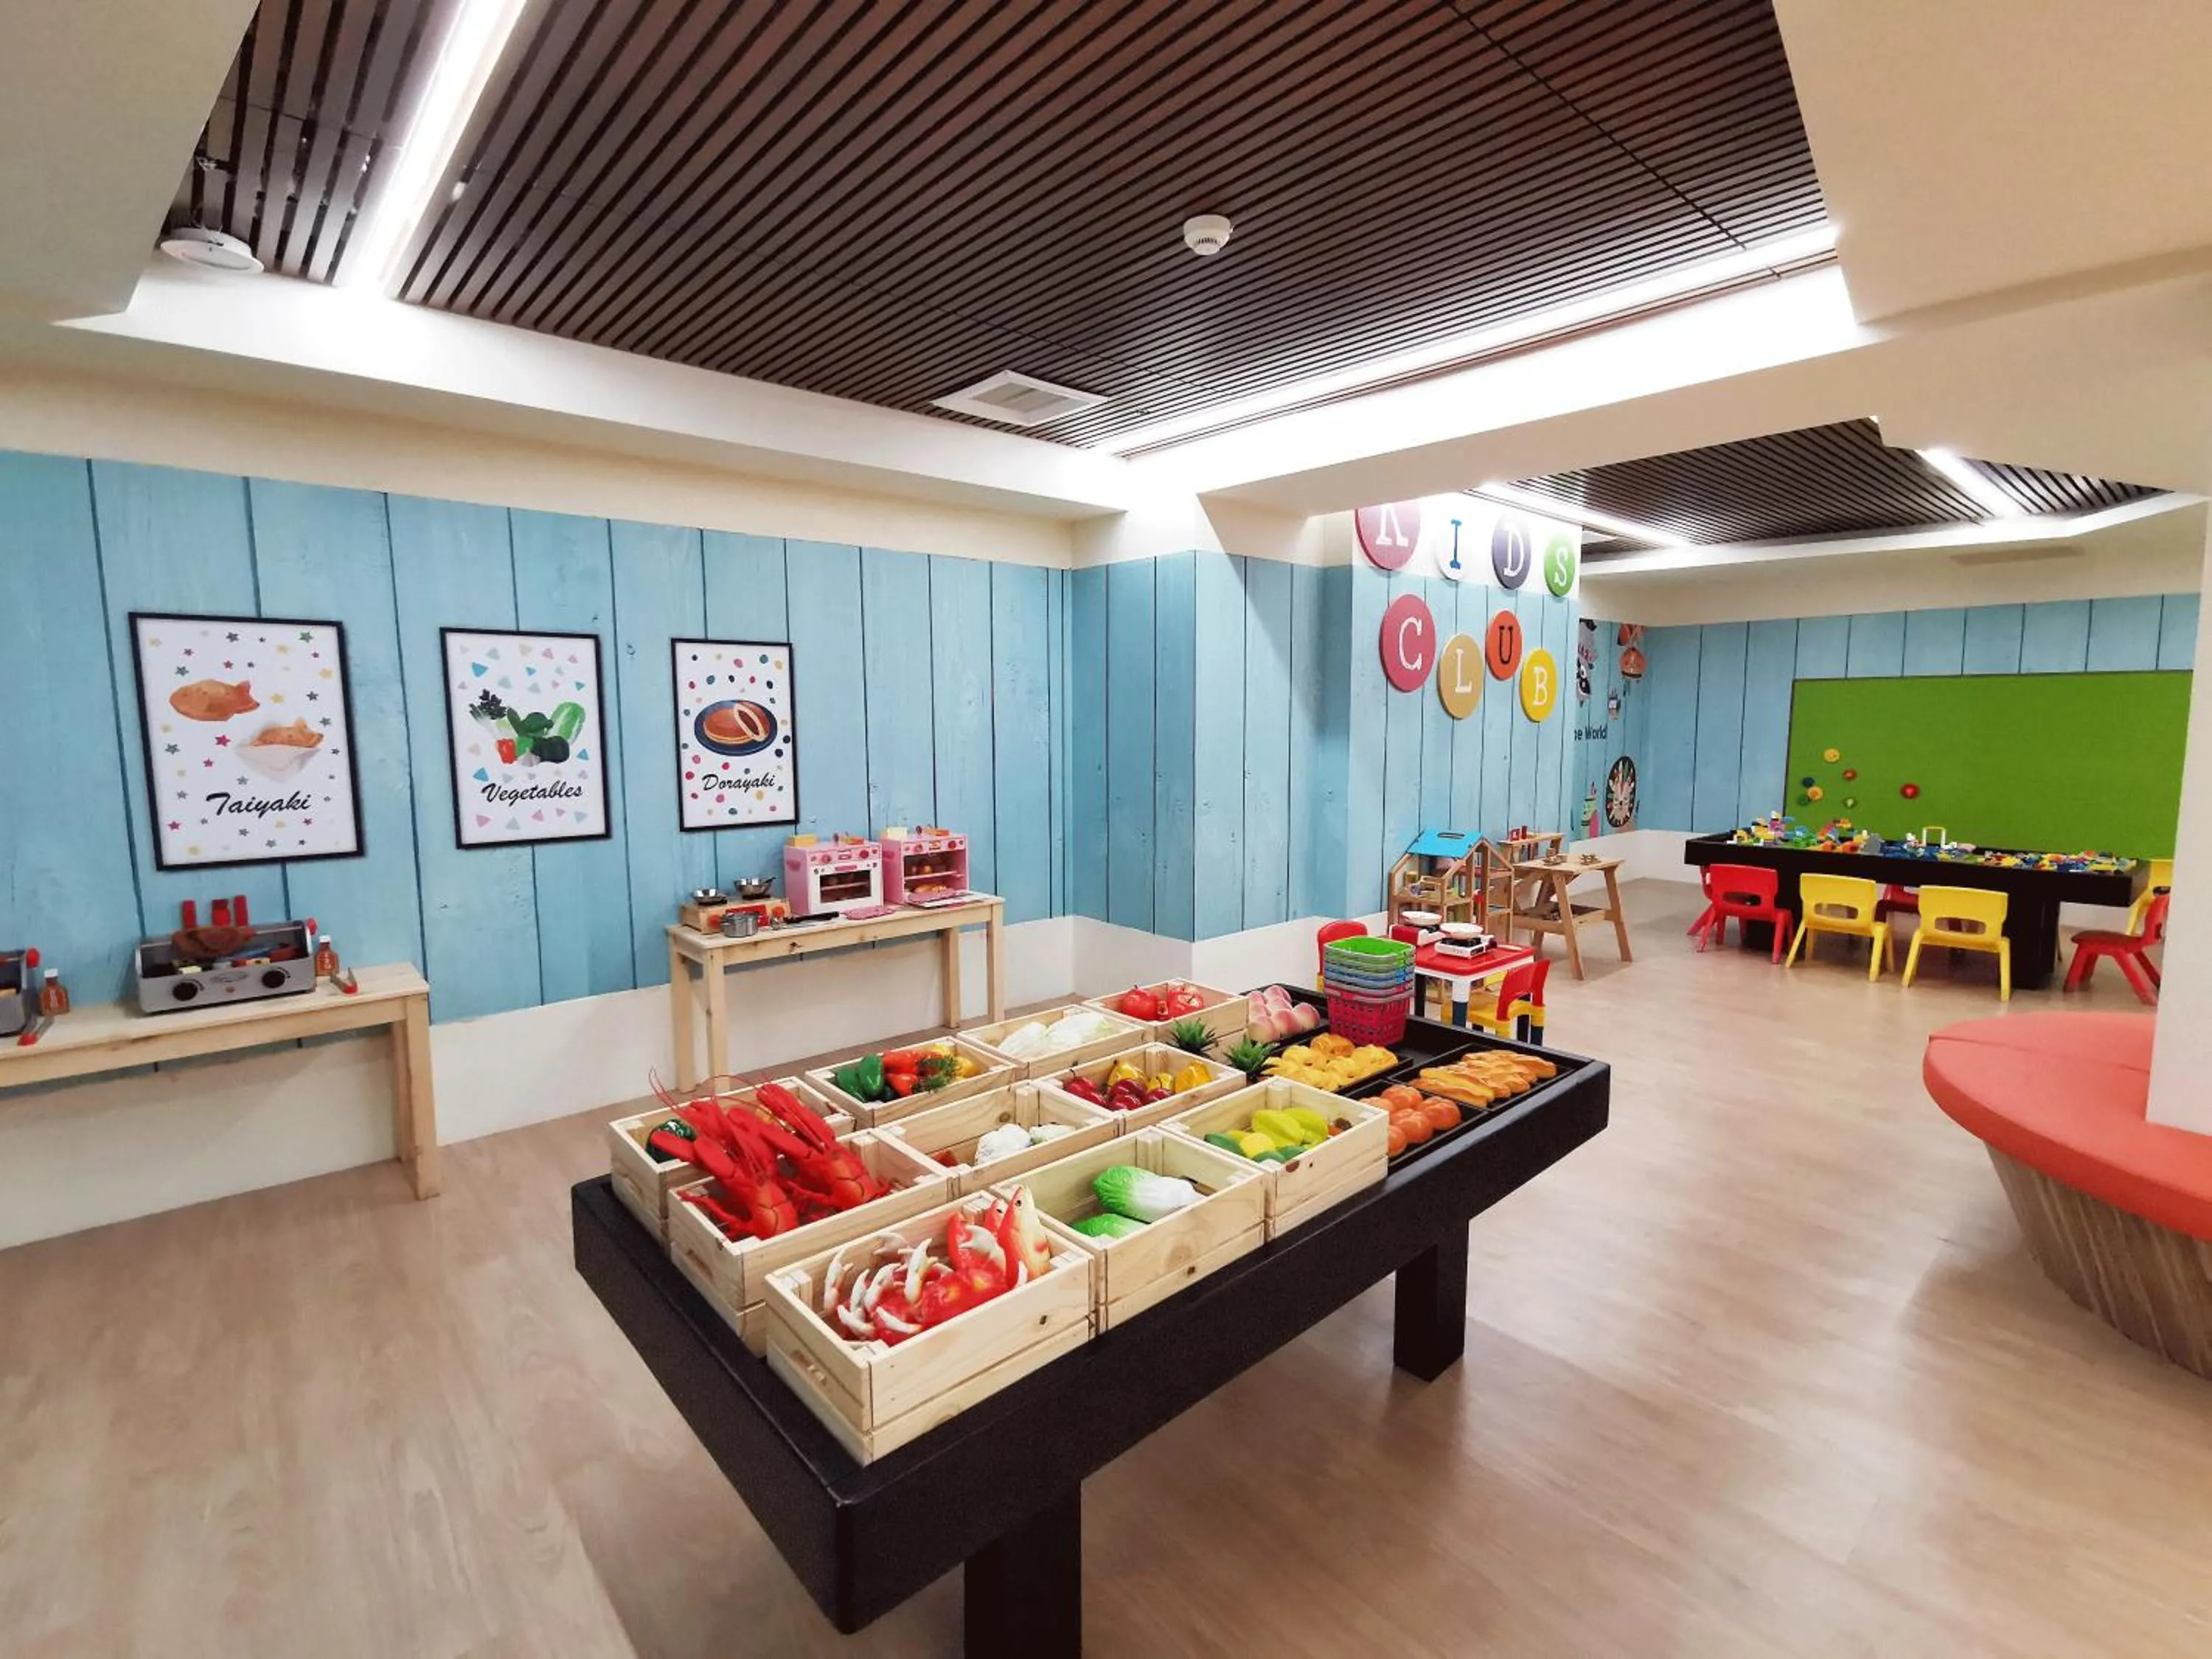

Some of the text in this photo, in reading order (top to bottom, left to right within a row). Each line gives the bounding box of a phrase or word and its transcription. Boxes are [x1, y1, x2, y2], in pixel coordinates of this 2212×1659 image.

[1398, 616, 1549, 706] CLUB
[1585, 723, 1608, 740] World
[481, 779, 583, 807] Vegetables
[701, 772, 776, 793] Dorayaki
[206, 790, 312, 819] Taiyaki
